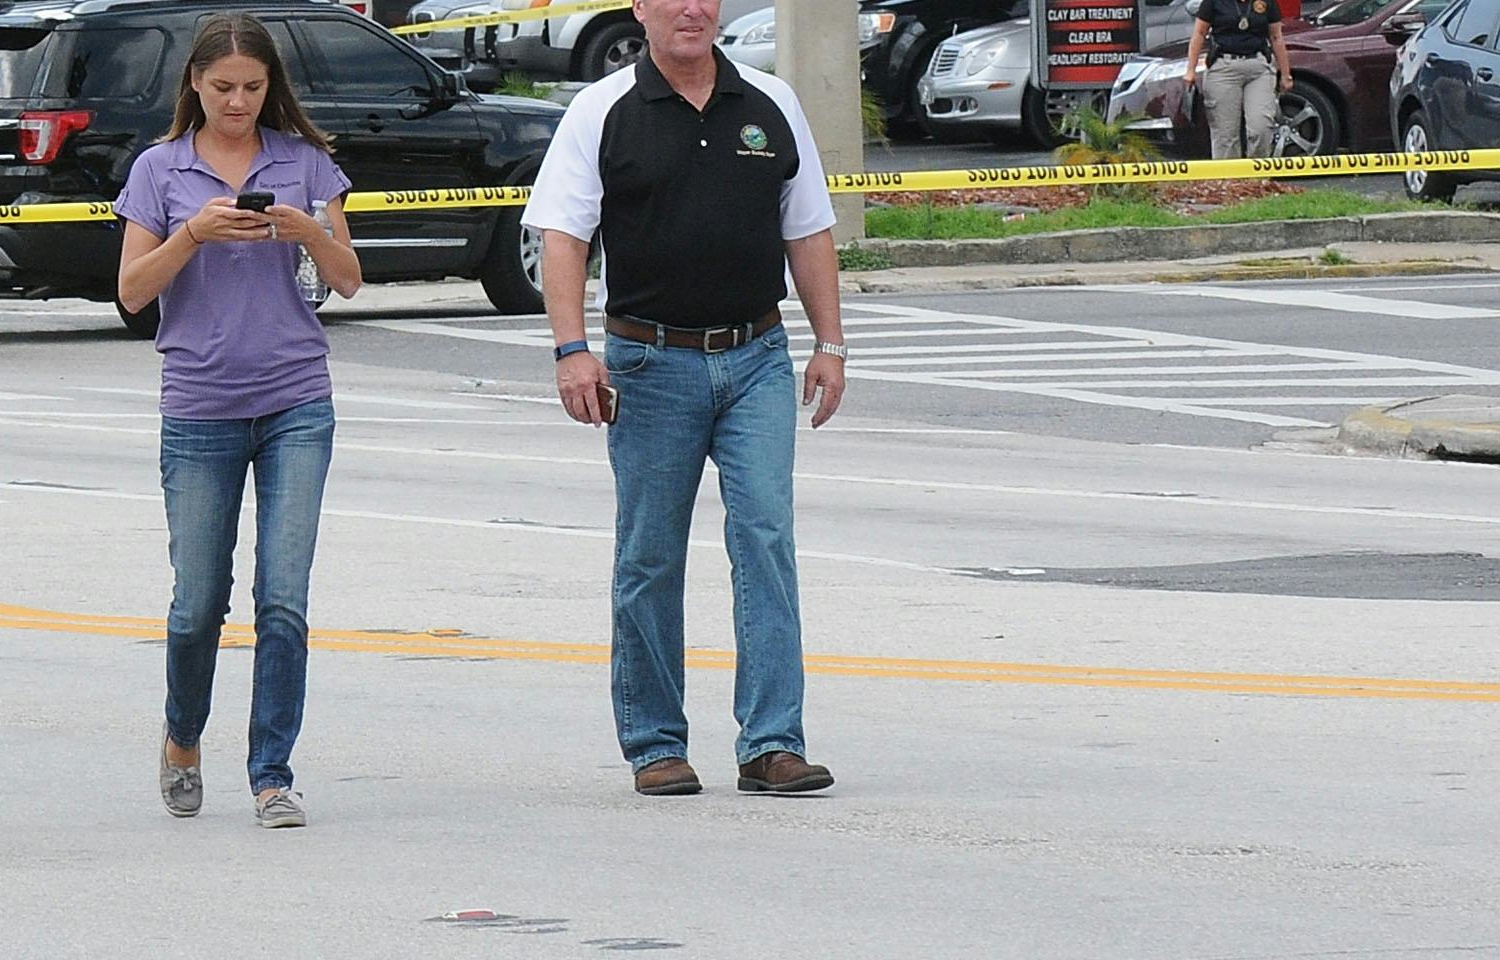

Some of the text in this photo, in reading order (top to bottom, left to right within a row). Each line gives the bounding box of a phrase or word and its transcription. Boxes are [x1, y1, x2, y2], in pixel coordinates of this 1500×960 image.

[1048, 8, 1133, 21] CLAY BAR TREATMENT
[1069, 31, 1112, 43] CLEAR BRA
